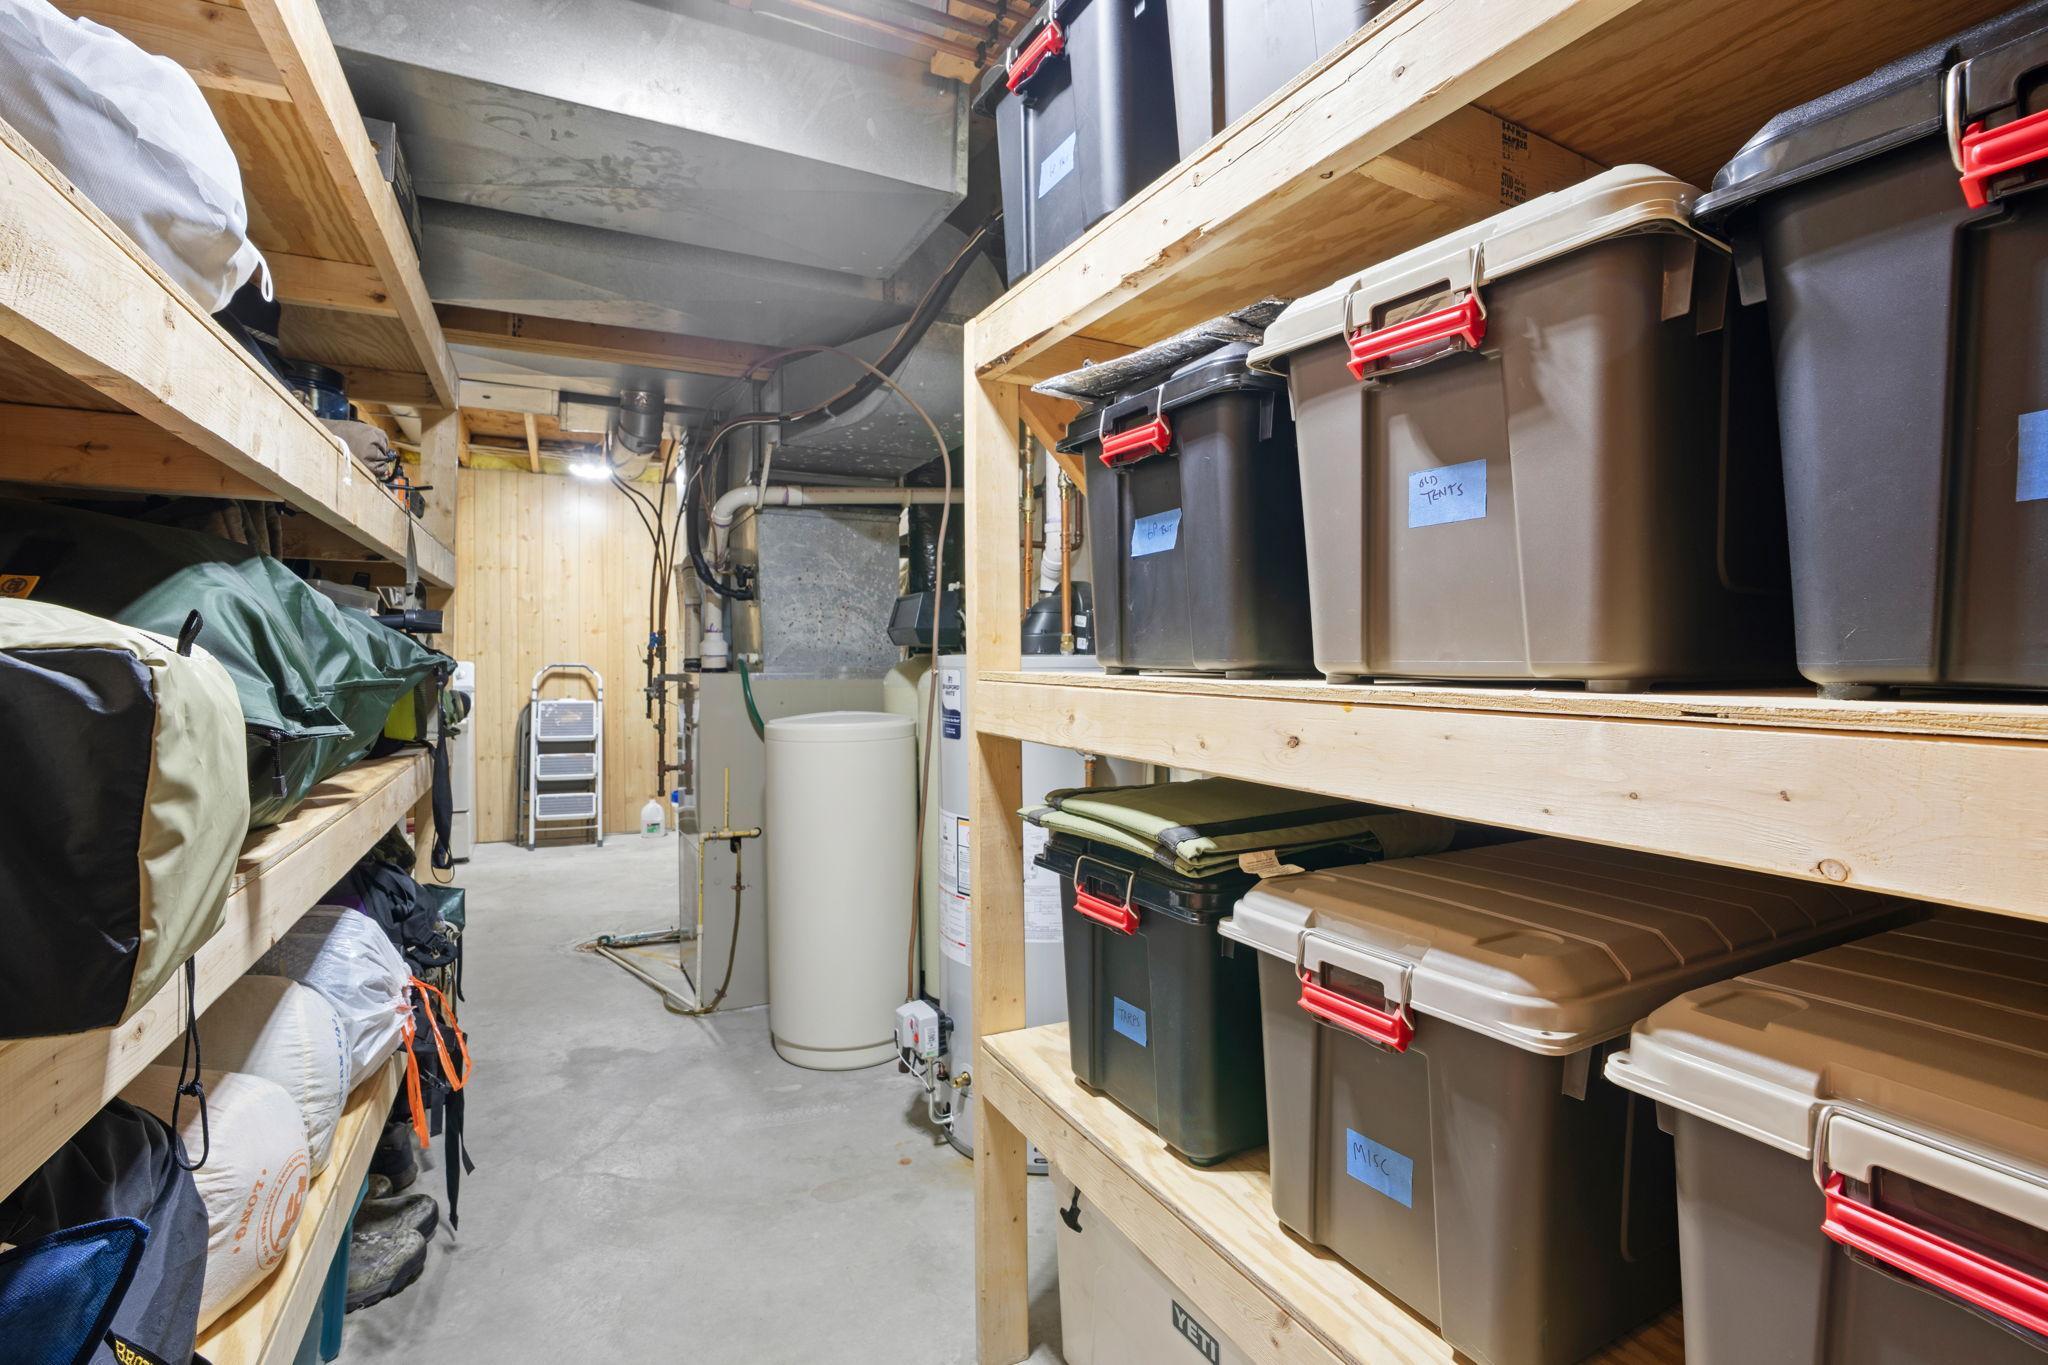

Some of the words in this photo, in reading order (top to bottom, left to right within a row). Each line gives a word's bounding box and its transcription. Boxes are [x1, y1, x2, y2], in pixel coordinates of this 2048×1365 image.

[1419, 482, 1464, 505] TENTS
[1353, 1141, 1391, 1176] MISC
[233, 1179, 265, 1242] LONG
[1174, 1305, 1217, 1363] YETI
